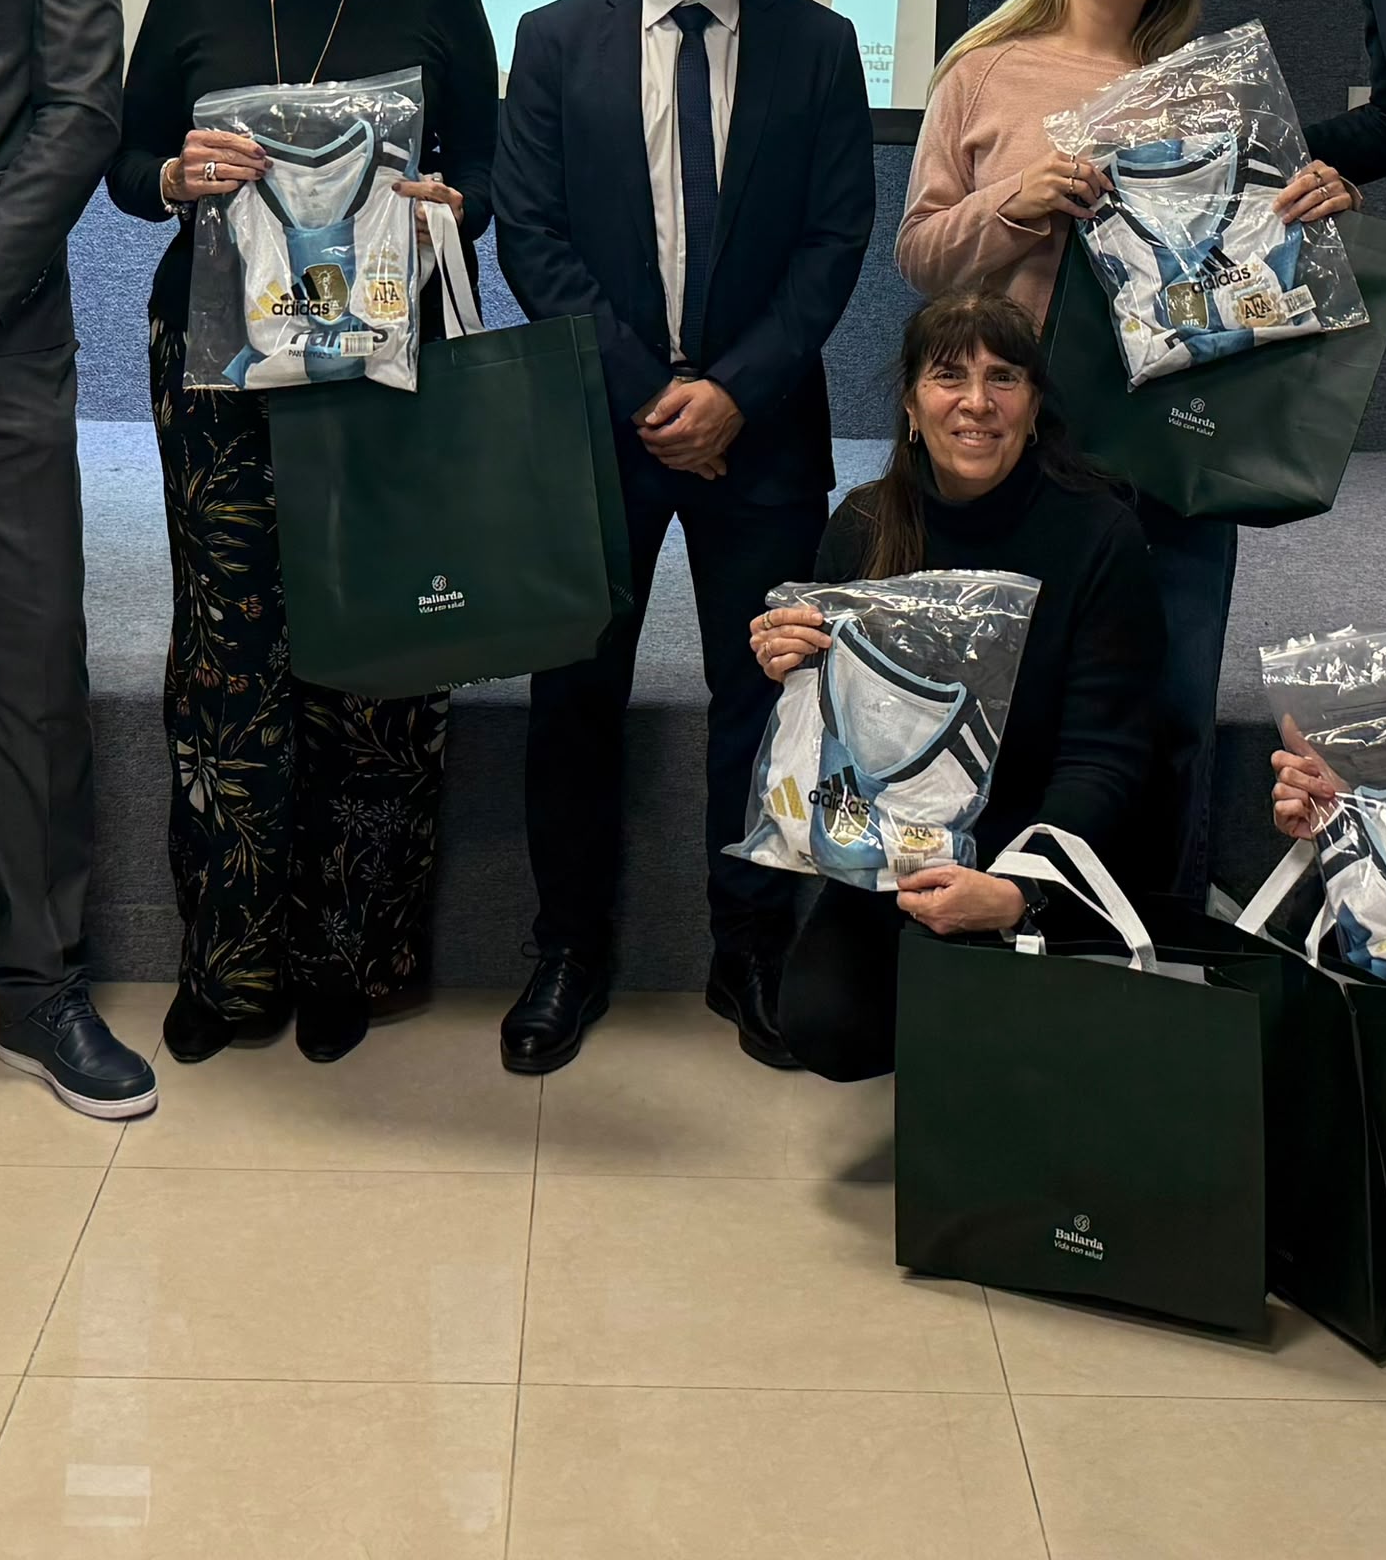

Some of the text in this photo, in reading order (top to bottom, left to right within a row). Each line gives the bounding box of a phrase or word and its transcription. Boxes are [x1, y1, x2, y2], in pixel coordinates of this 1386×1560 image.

[1191, 265, 1251, 293] adidas
[271, 300, 330, 317] adidas
[808, 790, 871, 816] adidas
[1055, 1228, 1104, 1251] Baliarda
